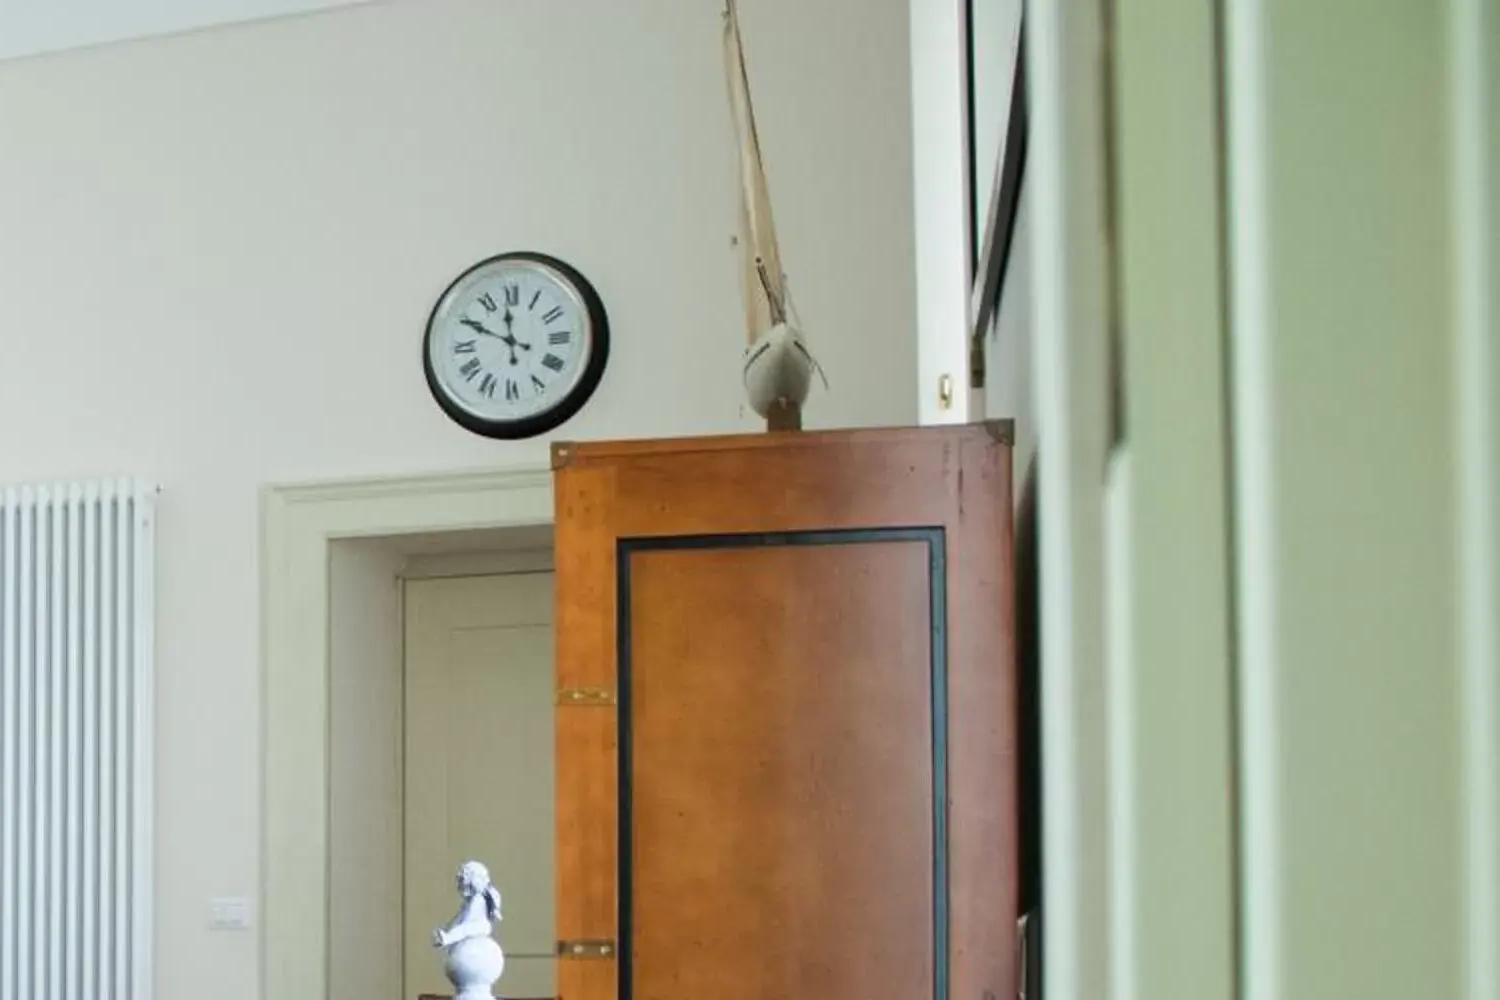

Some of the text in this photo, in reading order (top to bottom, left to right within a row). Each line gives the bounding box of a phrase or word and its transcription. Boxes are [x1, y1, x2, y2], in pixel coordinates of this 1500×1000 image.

[476, 291, 498, 317] XI
[503, 284, 519, 307] XII
[529, 290, 541, 311] I
[541, 305, 565, 325] II
[454, 339, 477, 354] IX
[547, 330, 572, 345] III
[459, 356, 482, 382] VIII
[478, 372, 498, 399] VII
[505, 377, 519, 402] VI
[530, 373, 545, 395] V
